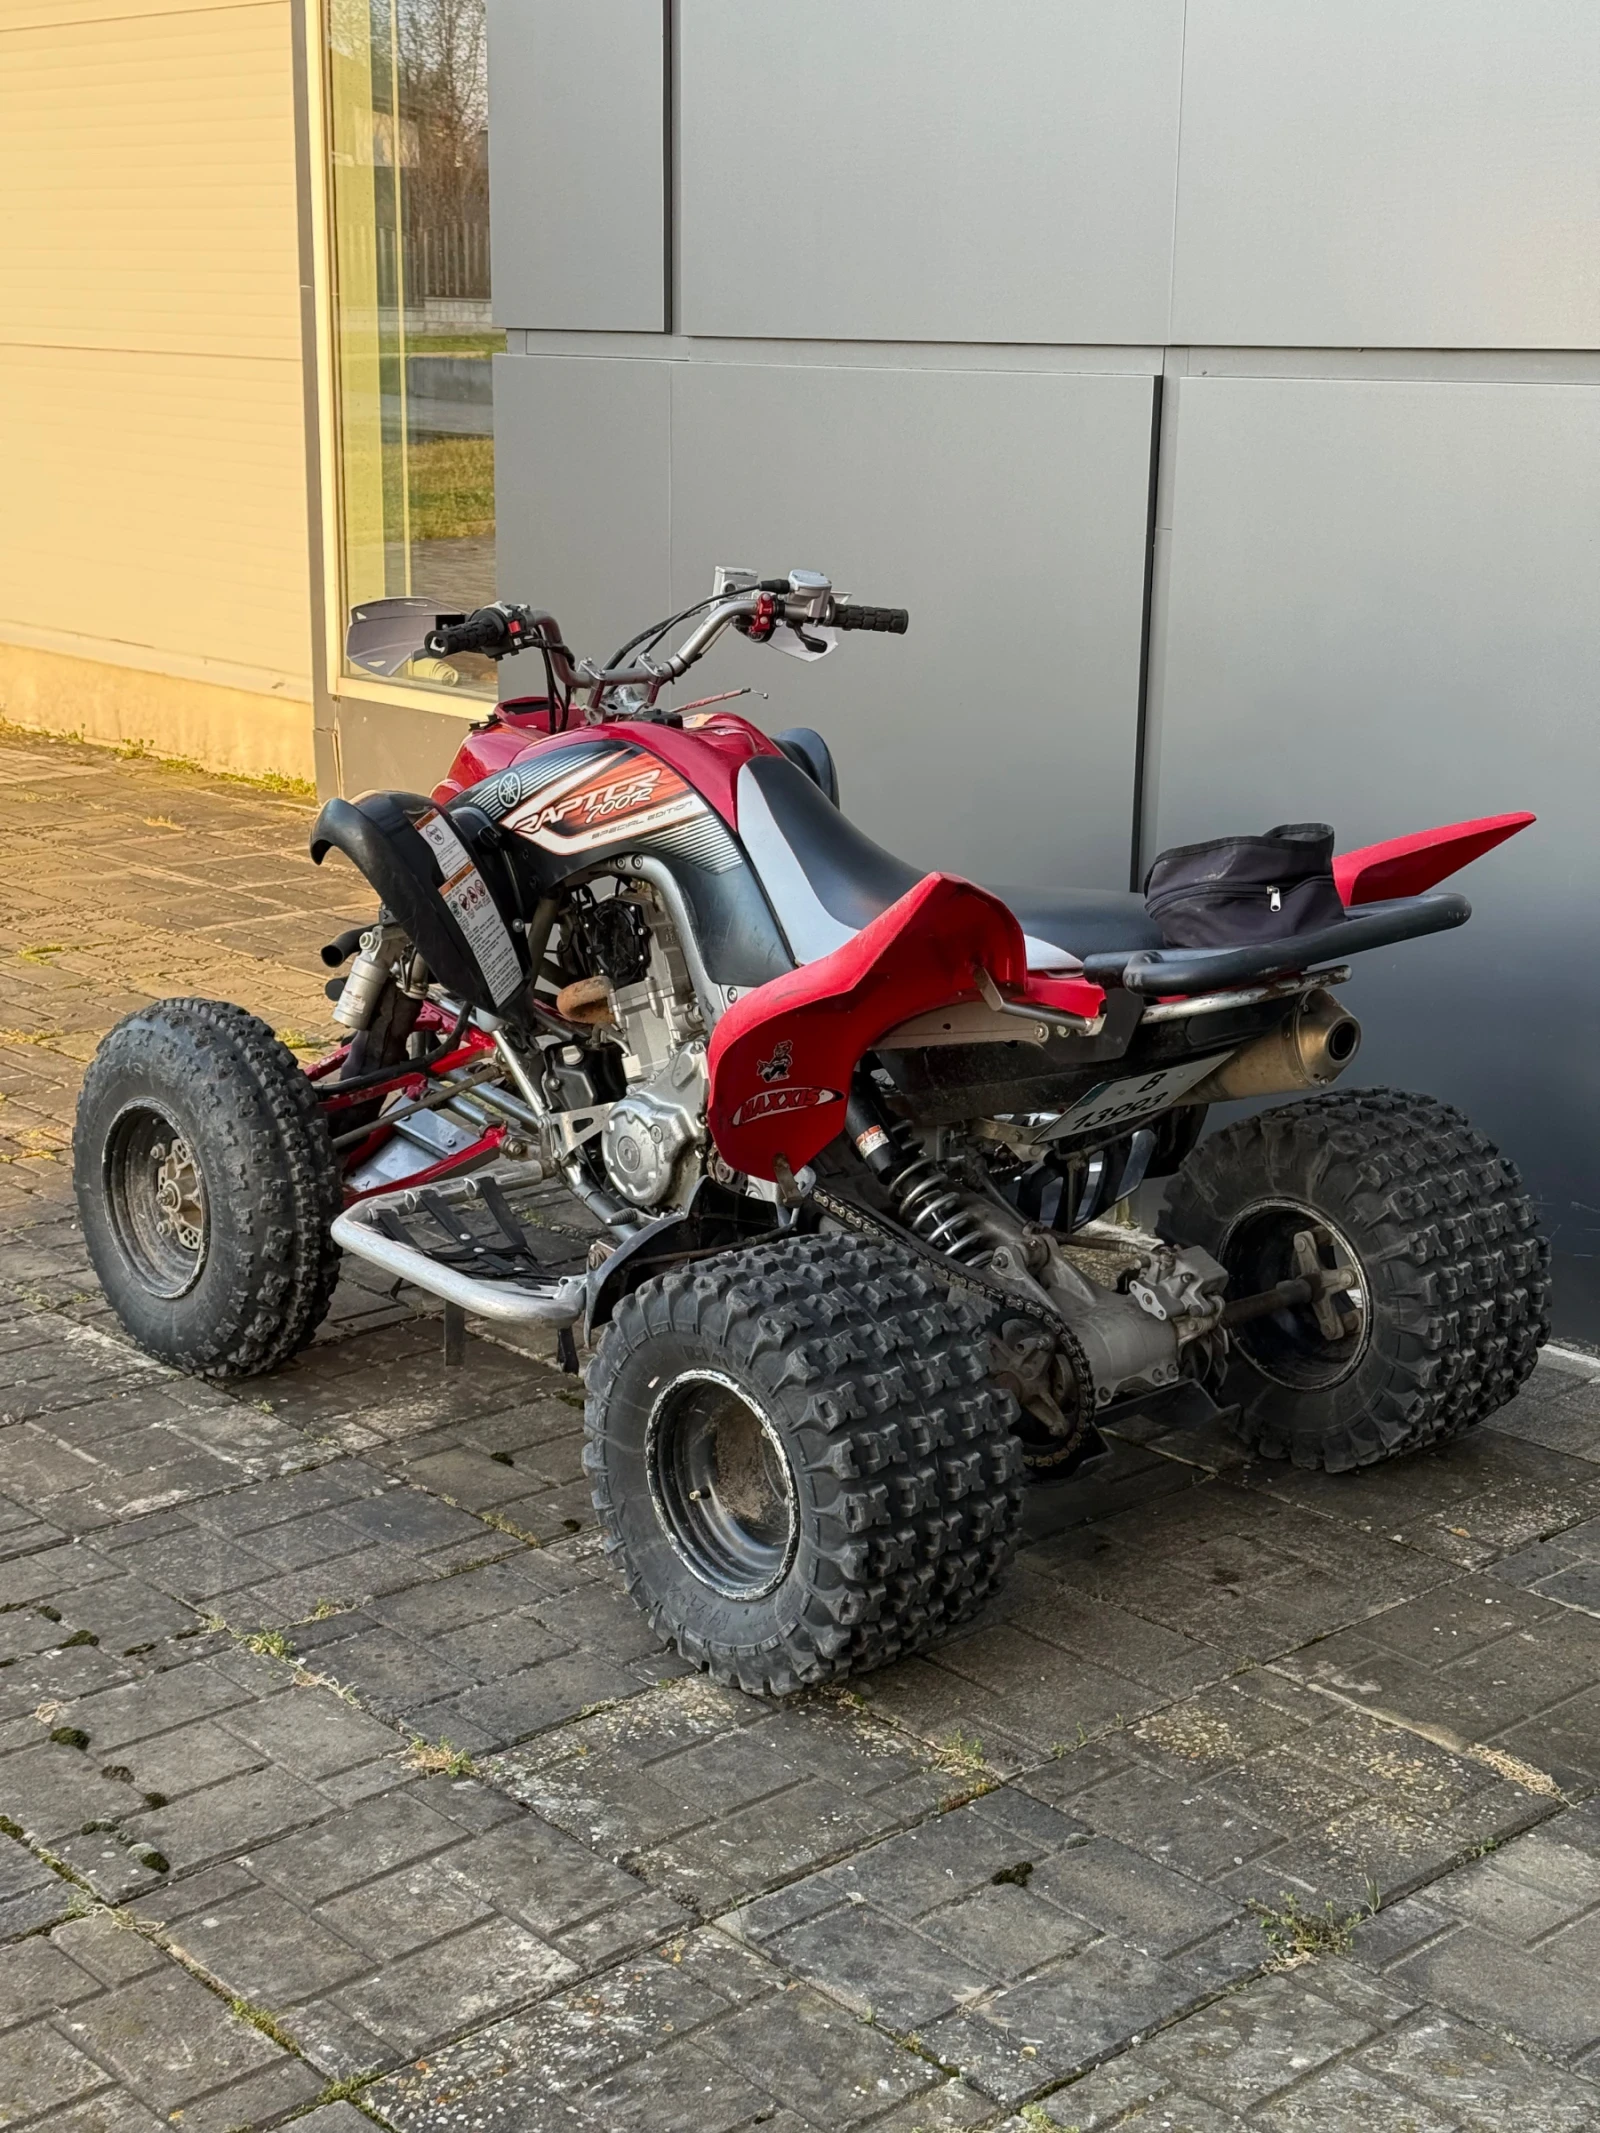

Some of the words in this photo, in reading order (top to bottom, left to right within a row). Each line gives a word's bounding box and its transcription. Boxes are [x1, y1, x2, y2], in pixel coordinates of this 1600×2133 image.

[511, 768, 667, 834] RAPTOR
[584, 787, 653, 824] 700R
[591, 819, 645, 840] SPECIAL
[647, 800, 693, 821] EDITION
[1136, 1072, 1168, 1094] B
[739, 1087, 822, 1124] MAXXIS
[1071, 1091, 1169, 1131] 13993
